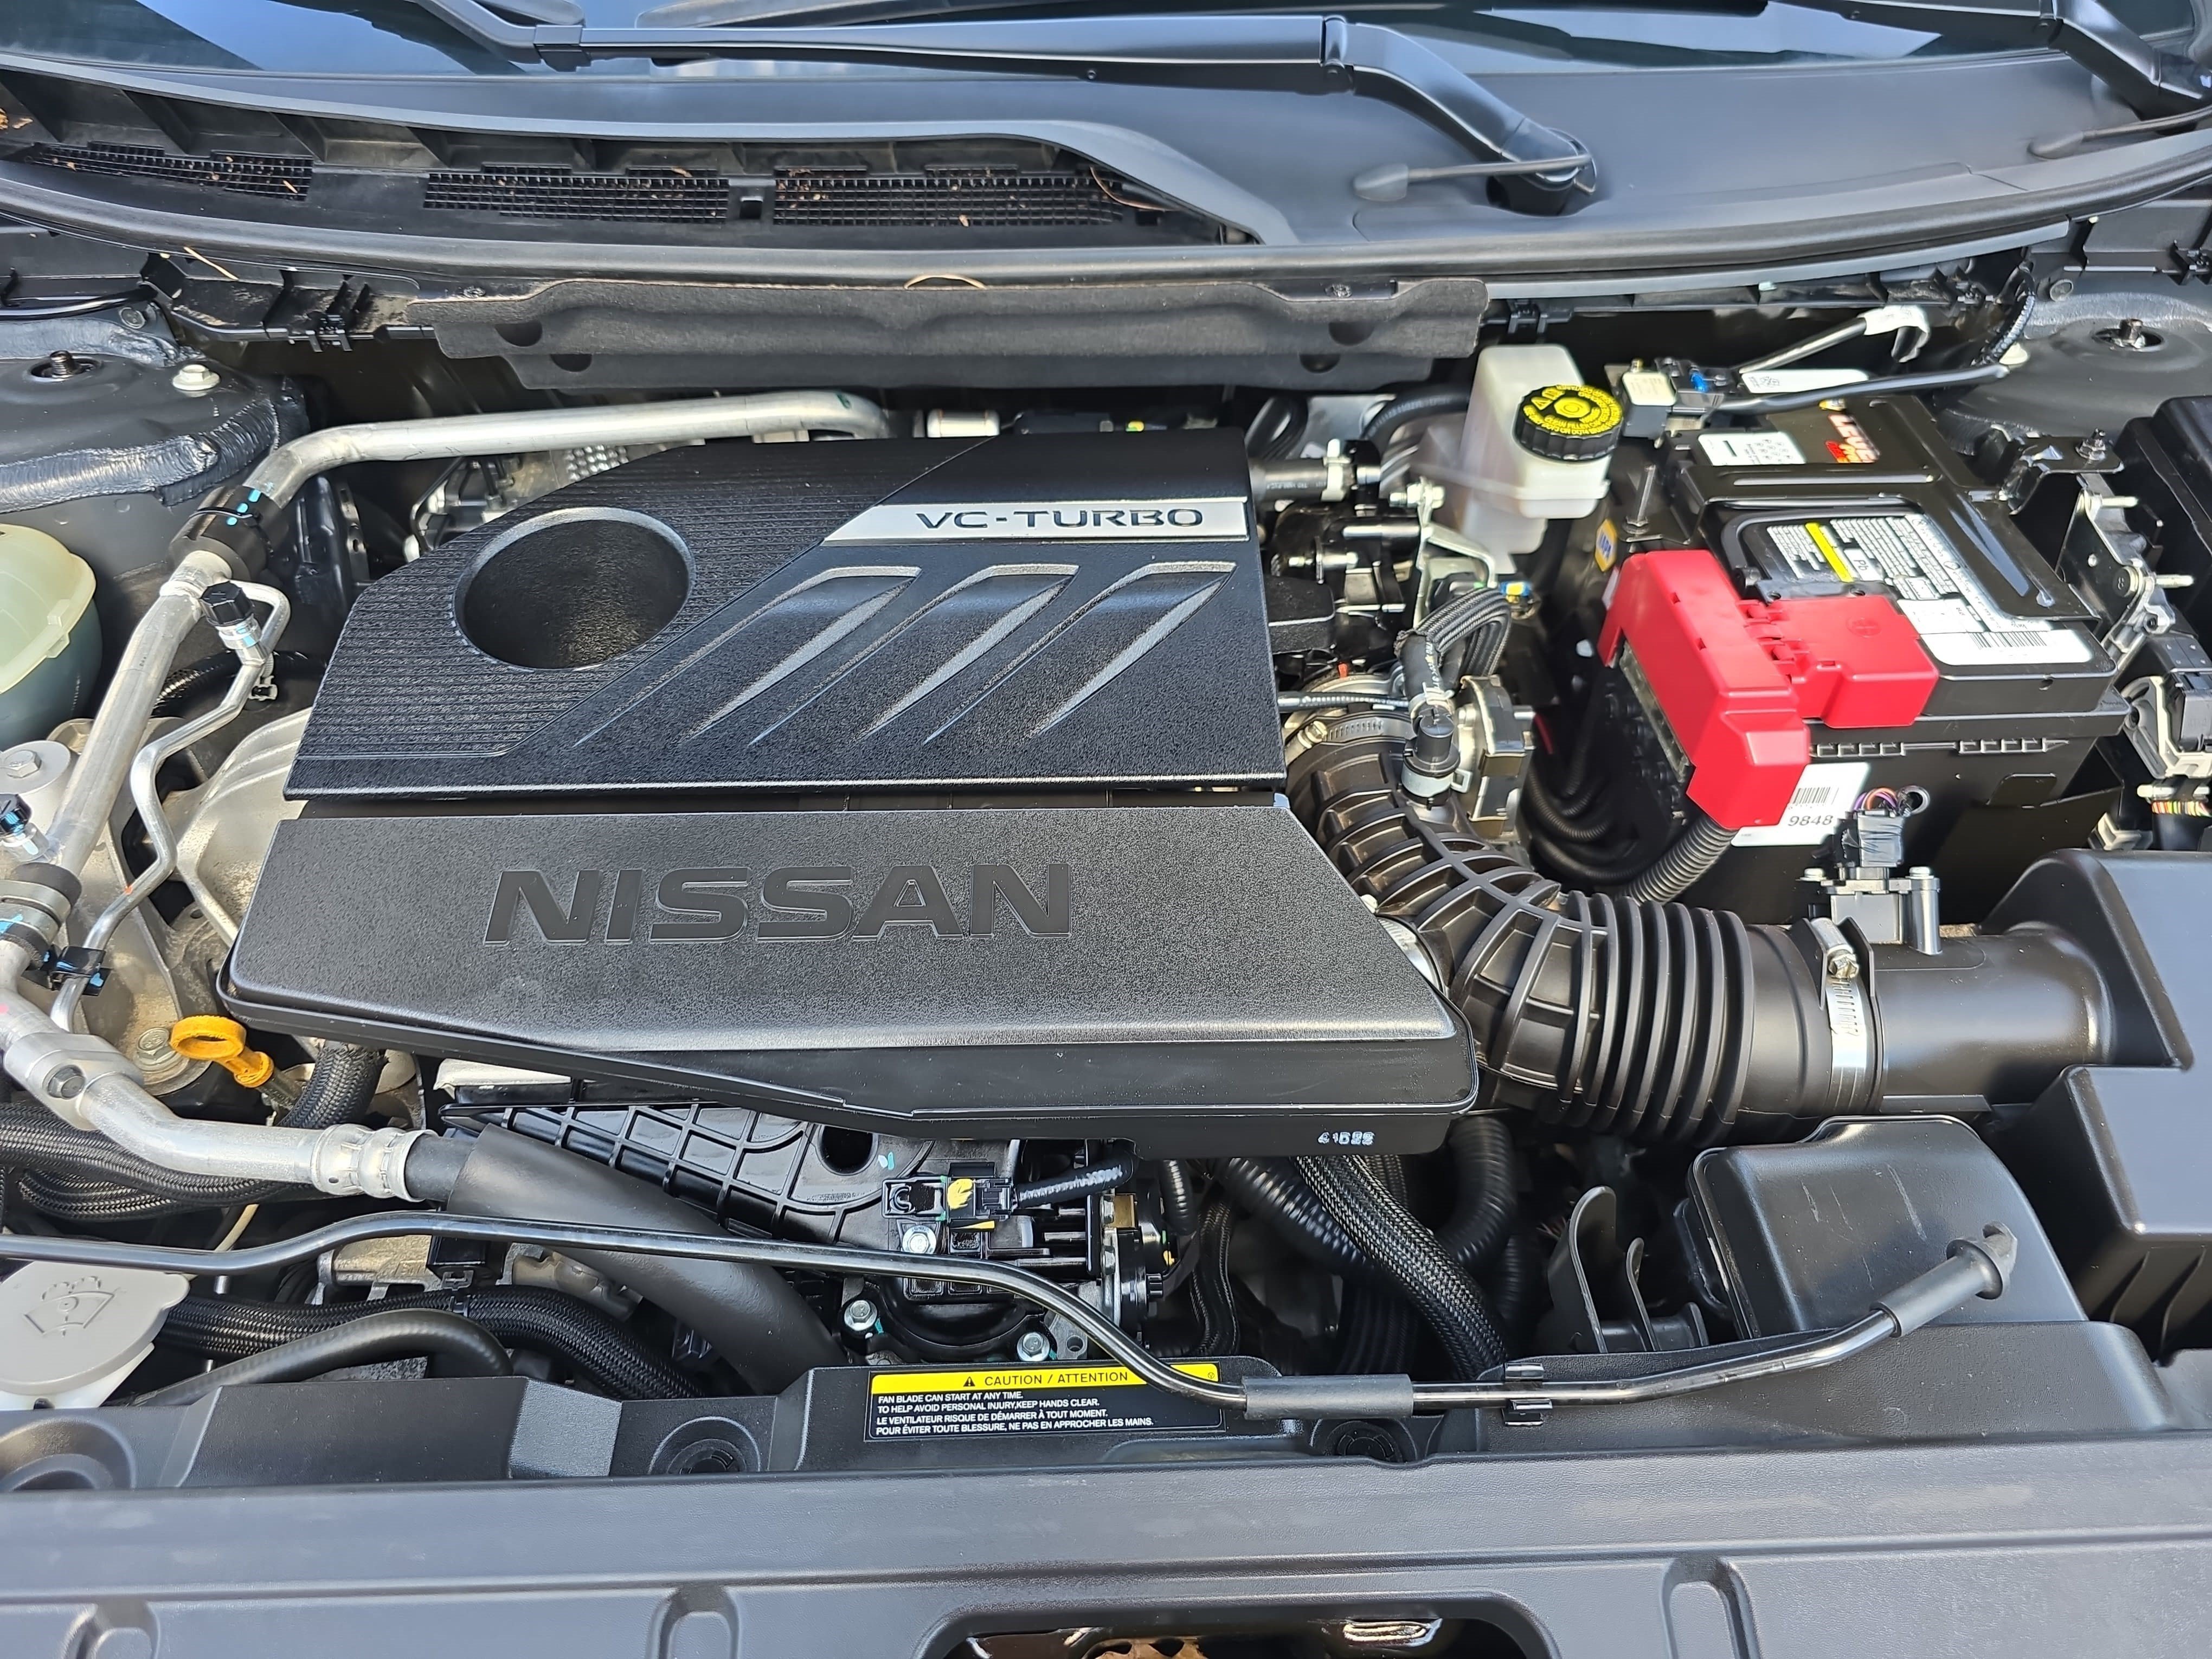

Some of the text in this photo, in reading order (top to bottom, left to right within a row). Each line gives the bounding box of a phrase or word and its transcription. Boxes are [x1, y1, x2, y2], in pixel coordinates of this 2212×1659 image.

[915, 507, 1204, 530] VC-TURBO
[1854, 560, 1869, 571] Pb
[1787, 814, 1834, 827] 9848
[483, 864, 1072, 945] NISSAN
[985, 1374, 1042, 1386] CAUTION
[1057, 1372, 1128, 1383] ATTENTION
[944, 1393, 971, 1401] START
[983, 1392, 1001, 1400] ANY
[1002, 1391, 1024, 1399] TIME.
[877, 1406, 890, 1414] TO
[891, 1405, 914, 1413] HELP
[913, 1404, 940, 1412] AVOID
[941, 1402, 987, 1411] PERSONAL
[1039, 1399, 1069, 1408] HANDS
[1070, 1398, 1100, 1407] CLEAR.
[876, 1417, 888, 1425] LE
[889, 1415, 943, 1425] VENTILATEUR
[944, 1413, 976, 1423] RISQUE
[991, 1410, 1037, 1421] DÉMARRER
[1038, 1409, 1045, 1419] À
[1045, 1411, 1069, 1419] TOUT
[1069, 1409, 1108, 1418] MOMENT.
[876, 1417, 1154, 1436] POUR ÉVITER TOUTE BLESSURE, NE PAS EN APPROCHER LES MAINS.
